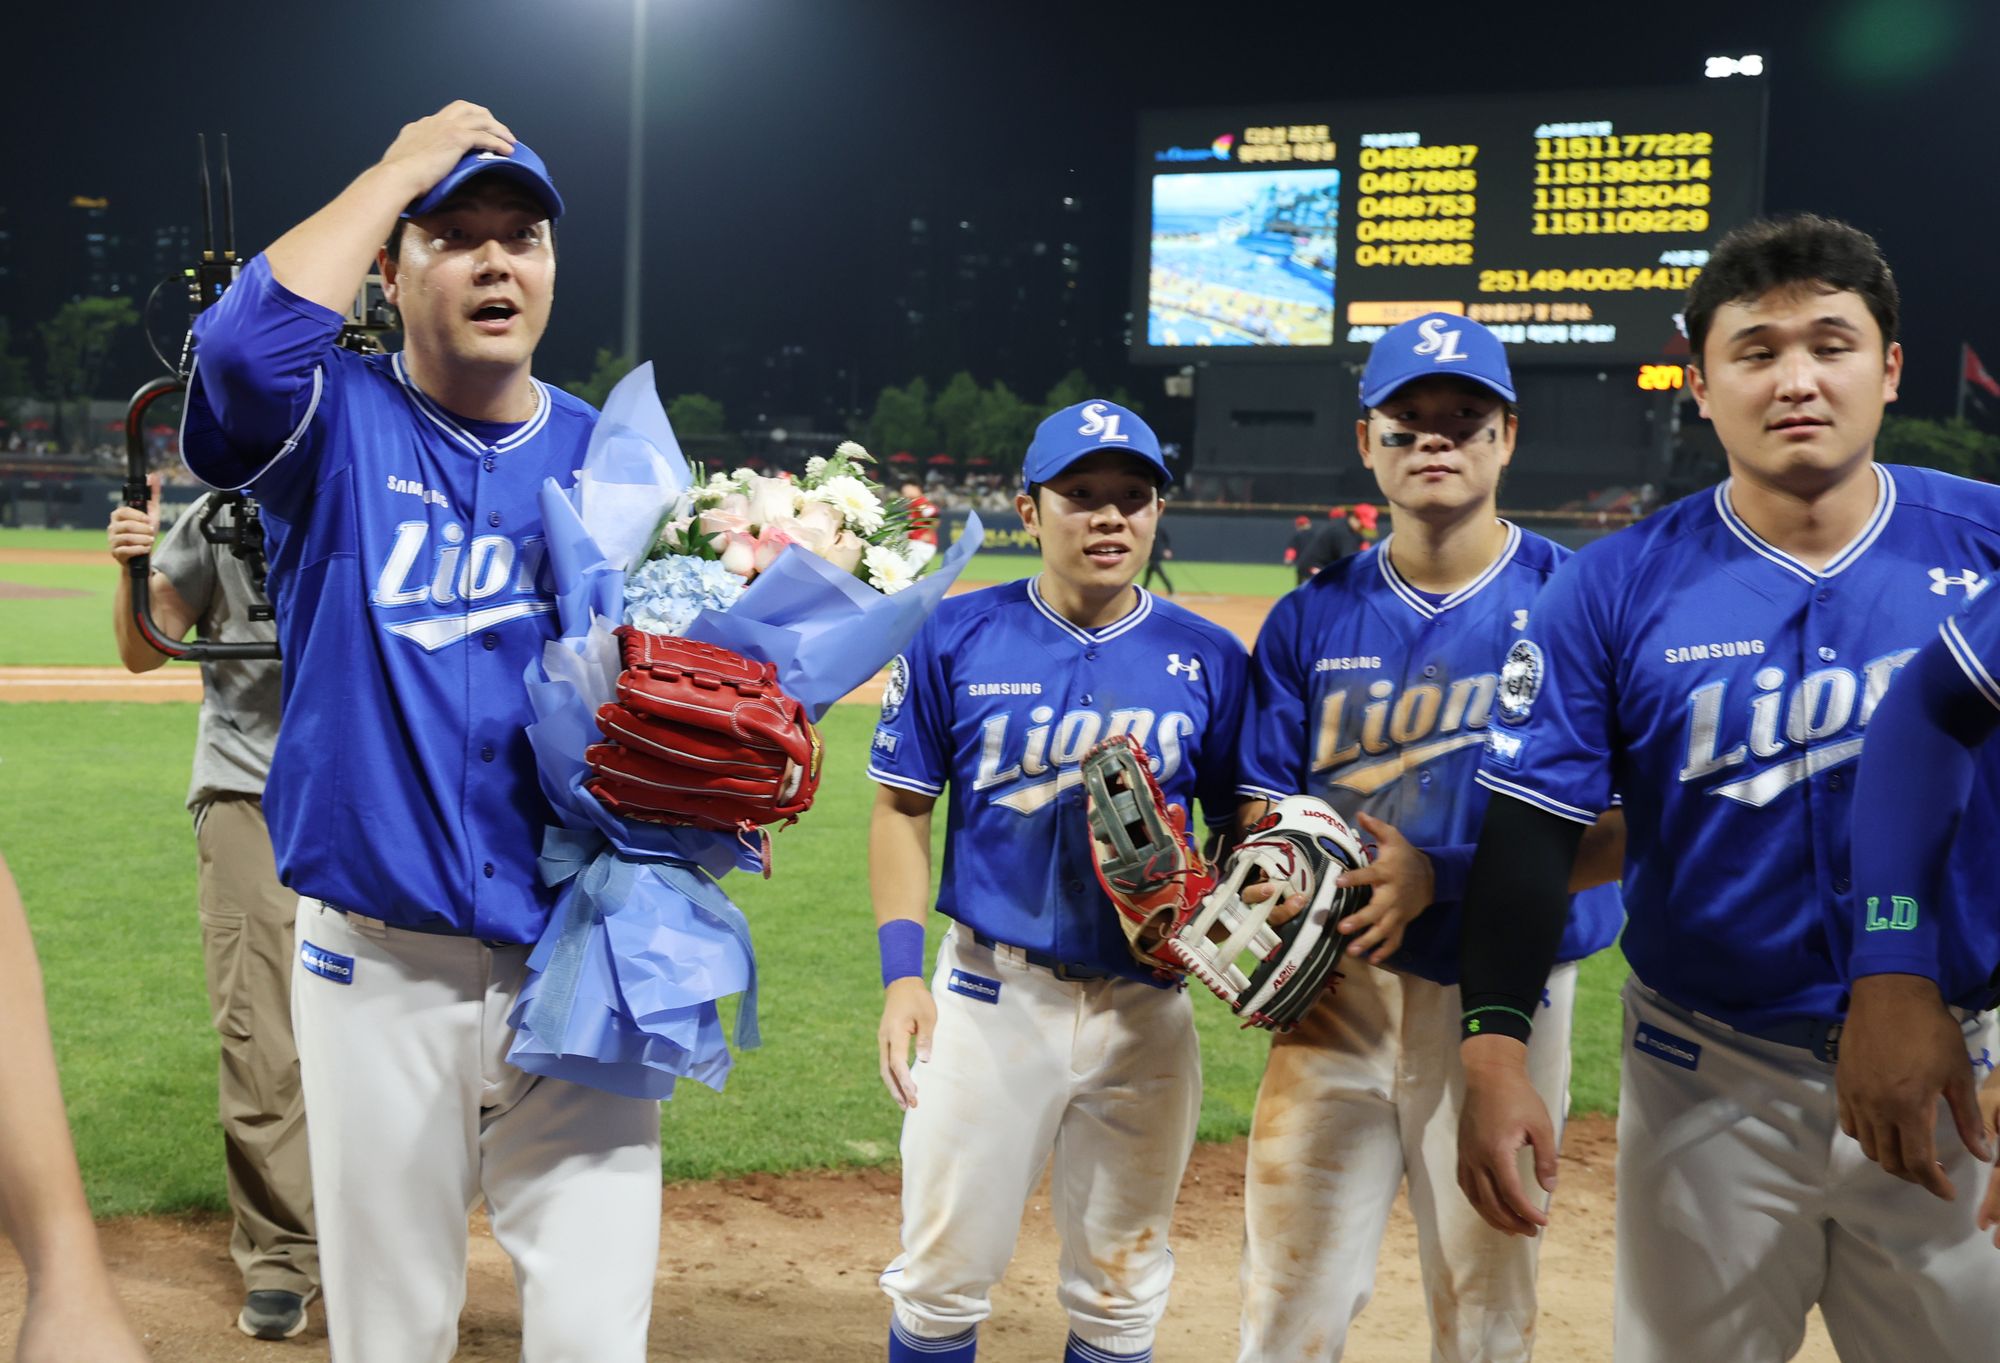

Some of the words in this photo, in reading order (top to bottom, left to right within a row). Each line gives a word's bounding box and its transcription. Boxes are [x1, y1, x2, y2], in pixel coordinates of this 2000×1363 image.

[1413, 318, 1469, 363] SL
[1078, 403, 1129, 443] SL
[373, 520, 559, 609] Lion
[1315, 656, 1382, 672] SAMSUNG
[1665, 640, 1766, 664] SAMSUNG
[968, 683, 1042, 696] SAMSUNG
[1311, 674, 1500, 773] Lion
[1865, 895, 1919, 932] LD
